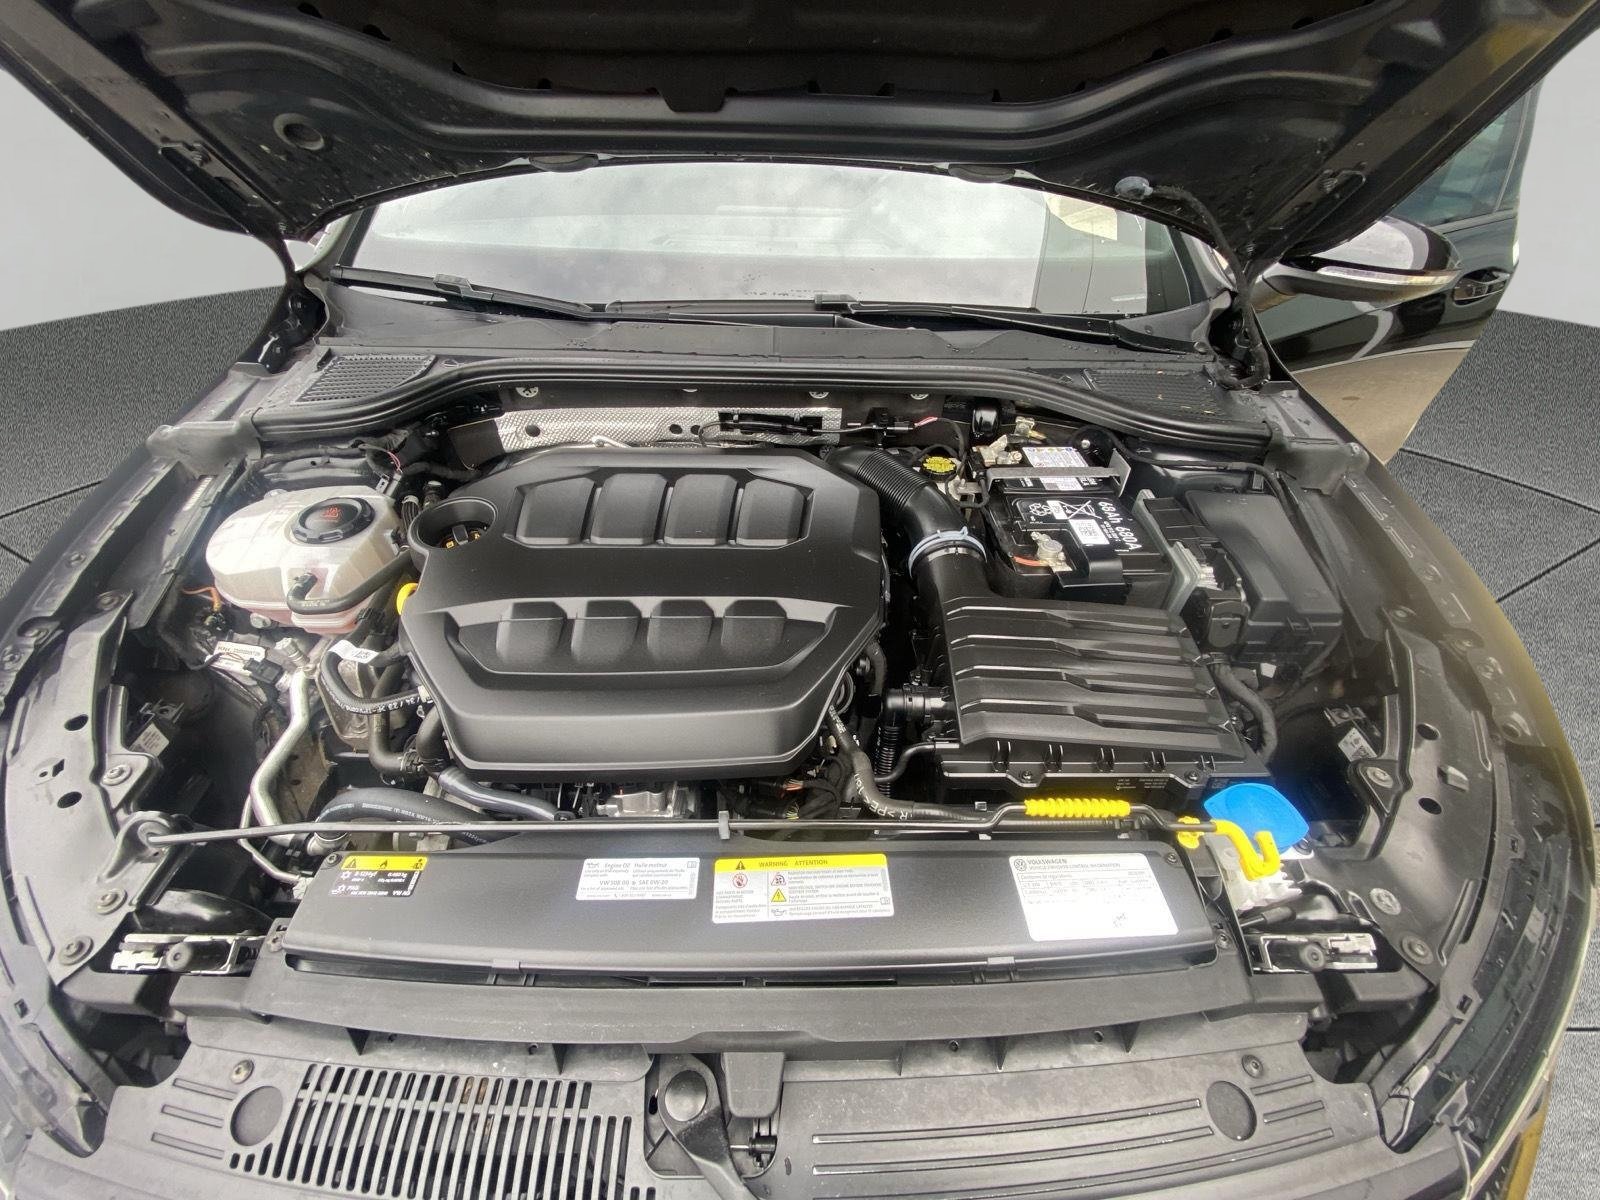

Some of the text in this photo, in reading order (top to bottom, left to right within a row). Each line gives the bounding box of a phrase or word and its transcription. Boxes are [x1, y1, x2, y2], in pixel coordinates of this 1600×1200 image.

[1098, 501, 1123, 524] 68Ah
[1115, 526, 1142, 551] 680A
[604, 862, 622, 870] Engine
